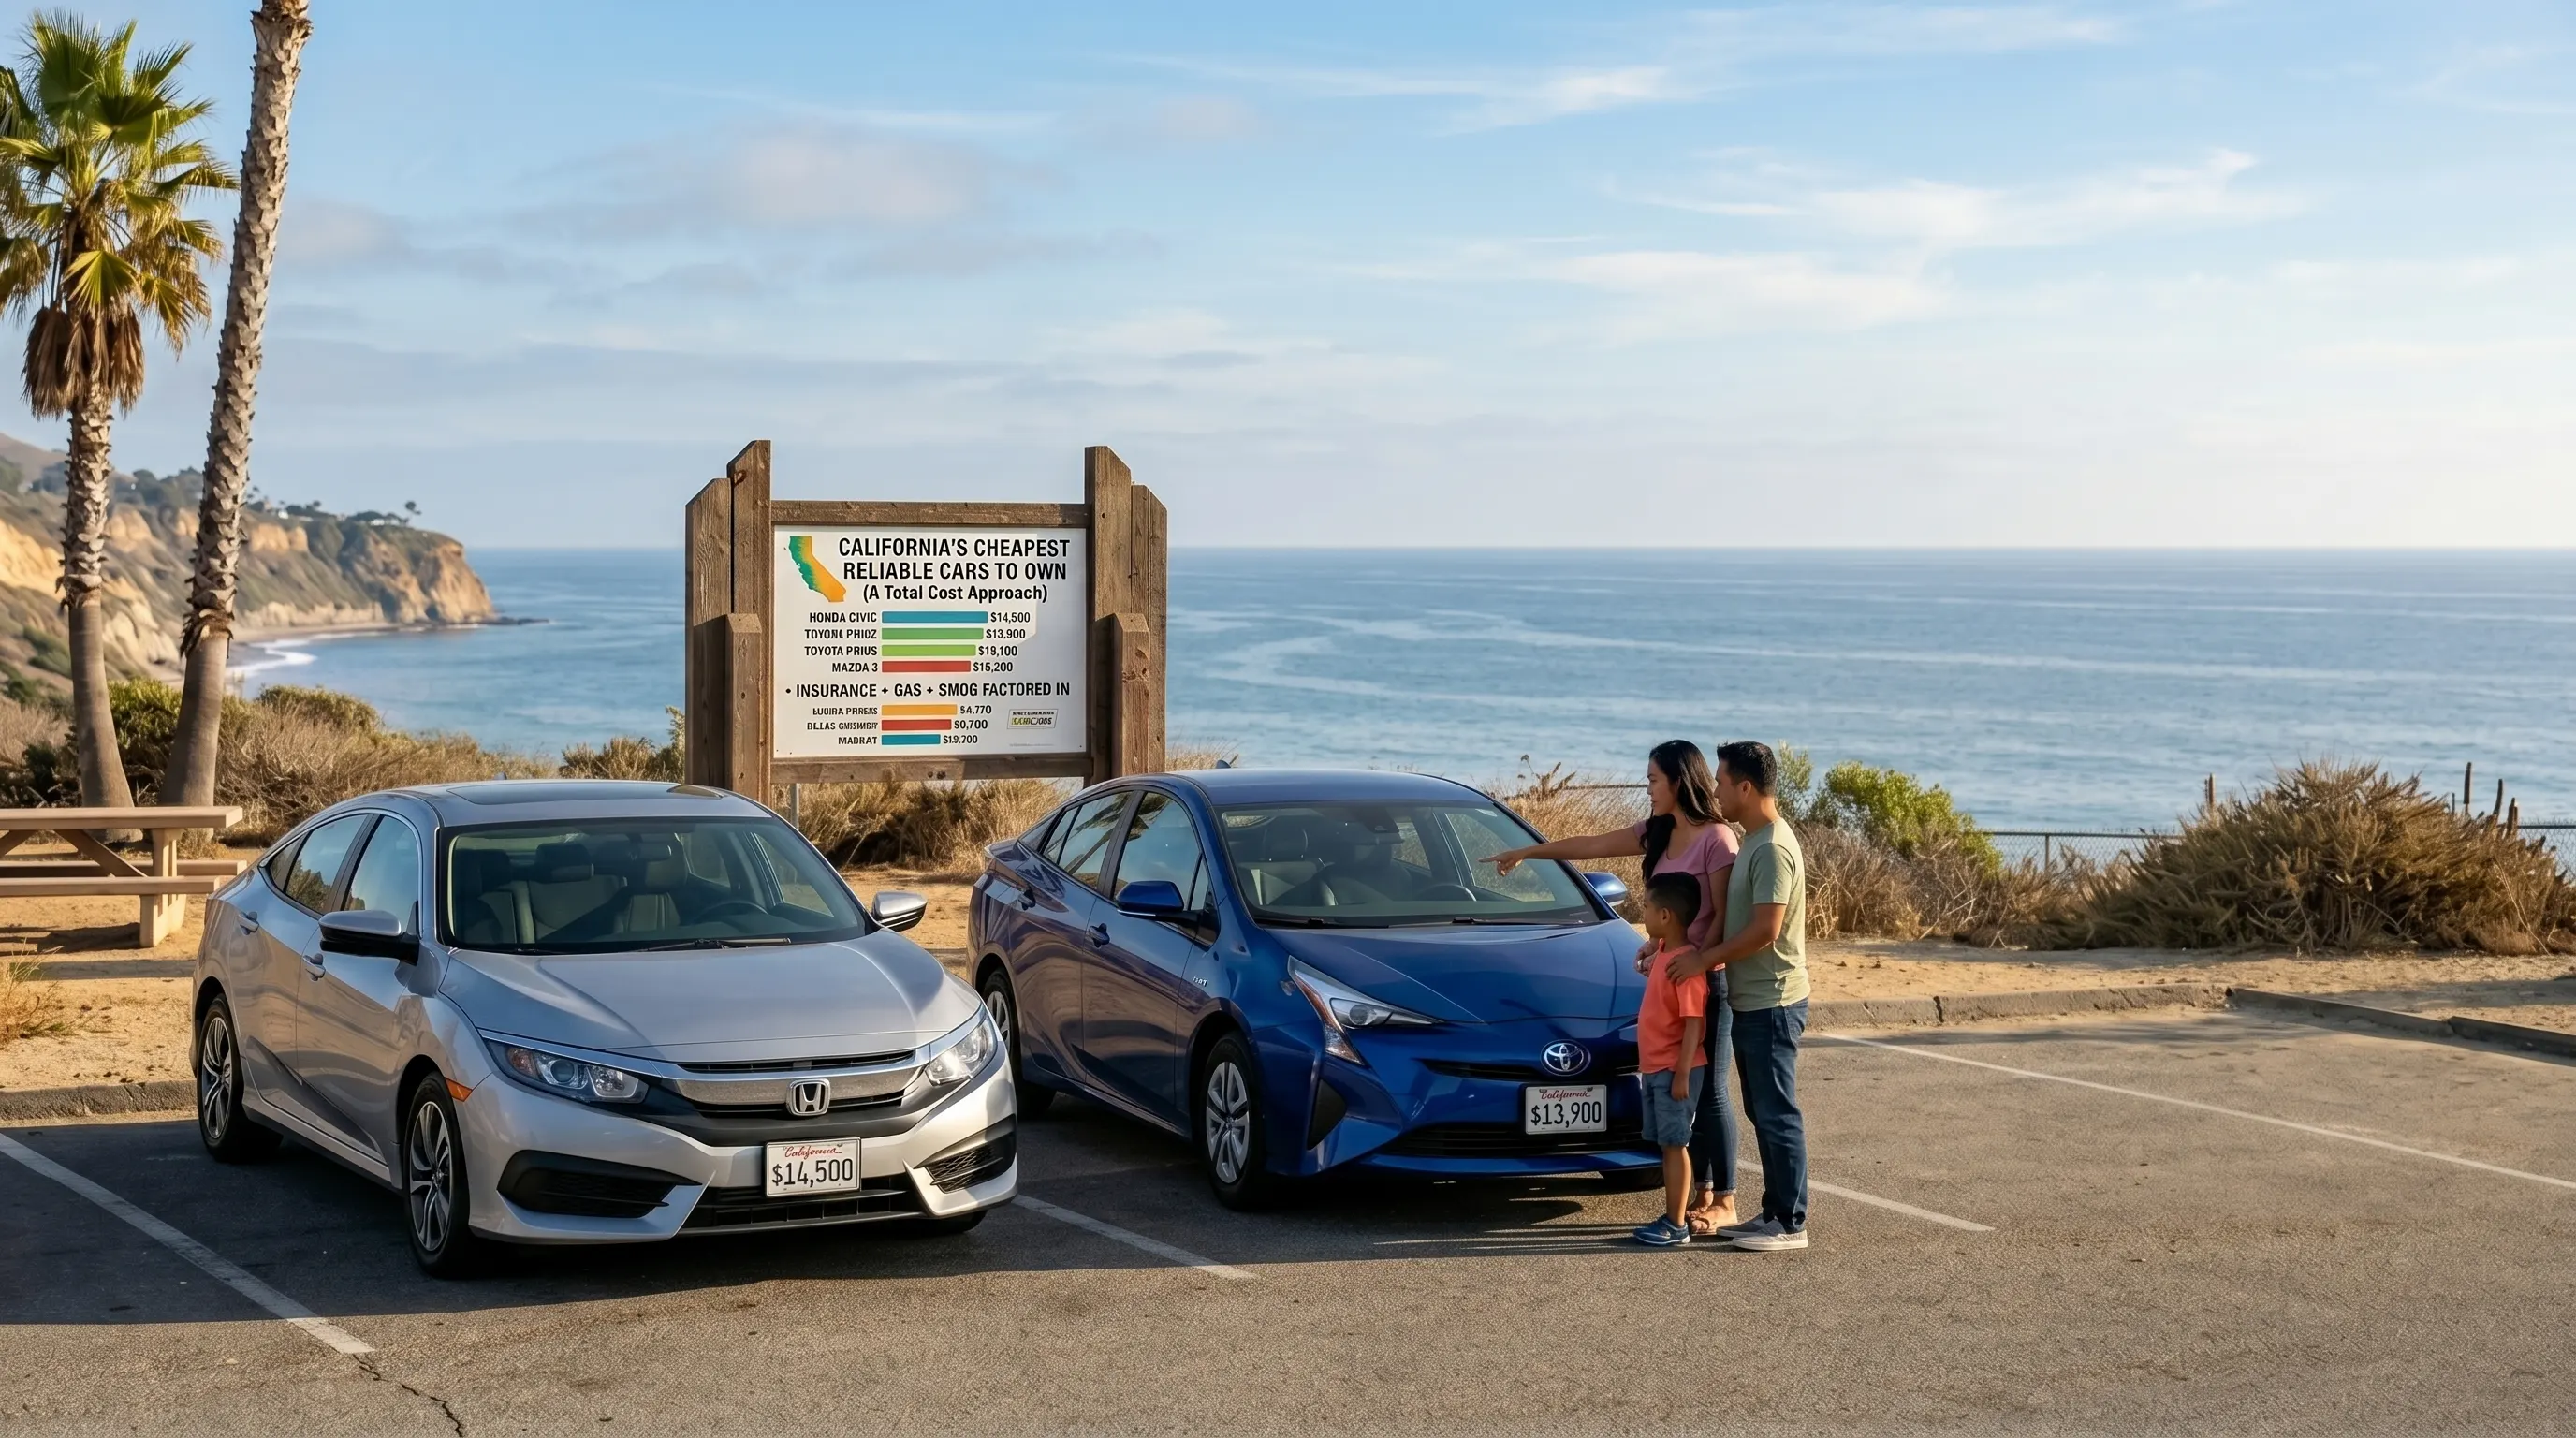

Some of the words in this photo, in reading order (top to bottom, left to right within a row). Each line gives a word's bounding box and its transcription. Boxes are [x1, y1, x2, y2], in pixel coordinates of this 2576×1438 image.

[839, 537, 968, 557] CALIFORNIA'S
[973, 538, 1071, 558] CHEAPEST
[843, 562, 934, 580] RELIABLE
[939, 562, 990, 580] CARS
[994, 563, 1018, 580] TO
[1024, 563, 1067, 580] OWN
[863, 583, 880, 604] (A
[884, 584, 923, 601] Total
[928, 584, 964, 601] Cost
[967, 583, 1048, 605] Approach)
[809, 611, 847, 624] HONDA
[848, 611, 877, 624] CIVIC
[990, 611, 1031, 624] $14,500
[804, 645, 844, 656] TOYOTA
[845, 645, 878, 656] PRIUS
[831, 662, 870, 673] MAZDA
[871, 662, 878, 673] 3
[973, 661, 1014, 673] $15,200
[796, 683, 877, 697] INSURANCE
[894, 683, 922, 697] GAS
[938, 682, 978, 697] SMOG
[982, 682, 1052, 697] FACTORED
[1056, 682, 1070, 697] IN
[1530, 1101, 1602, 1128] $13,900
[771, 1158, 854, 1188] $14,500
